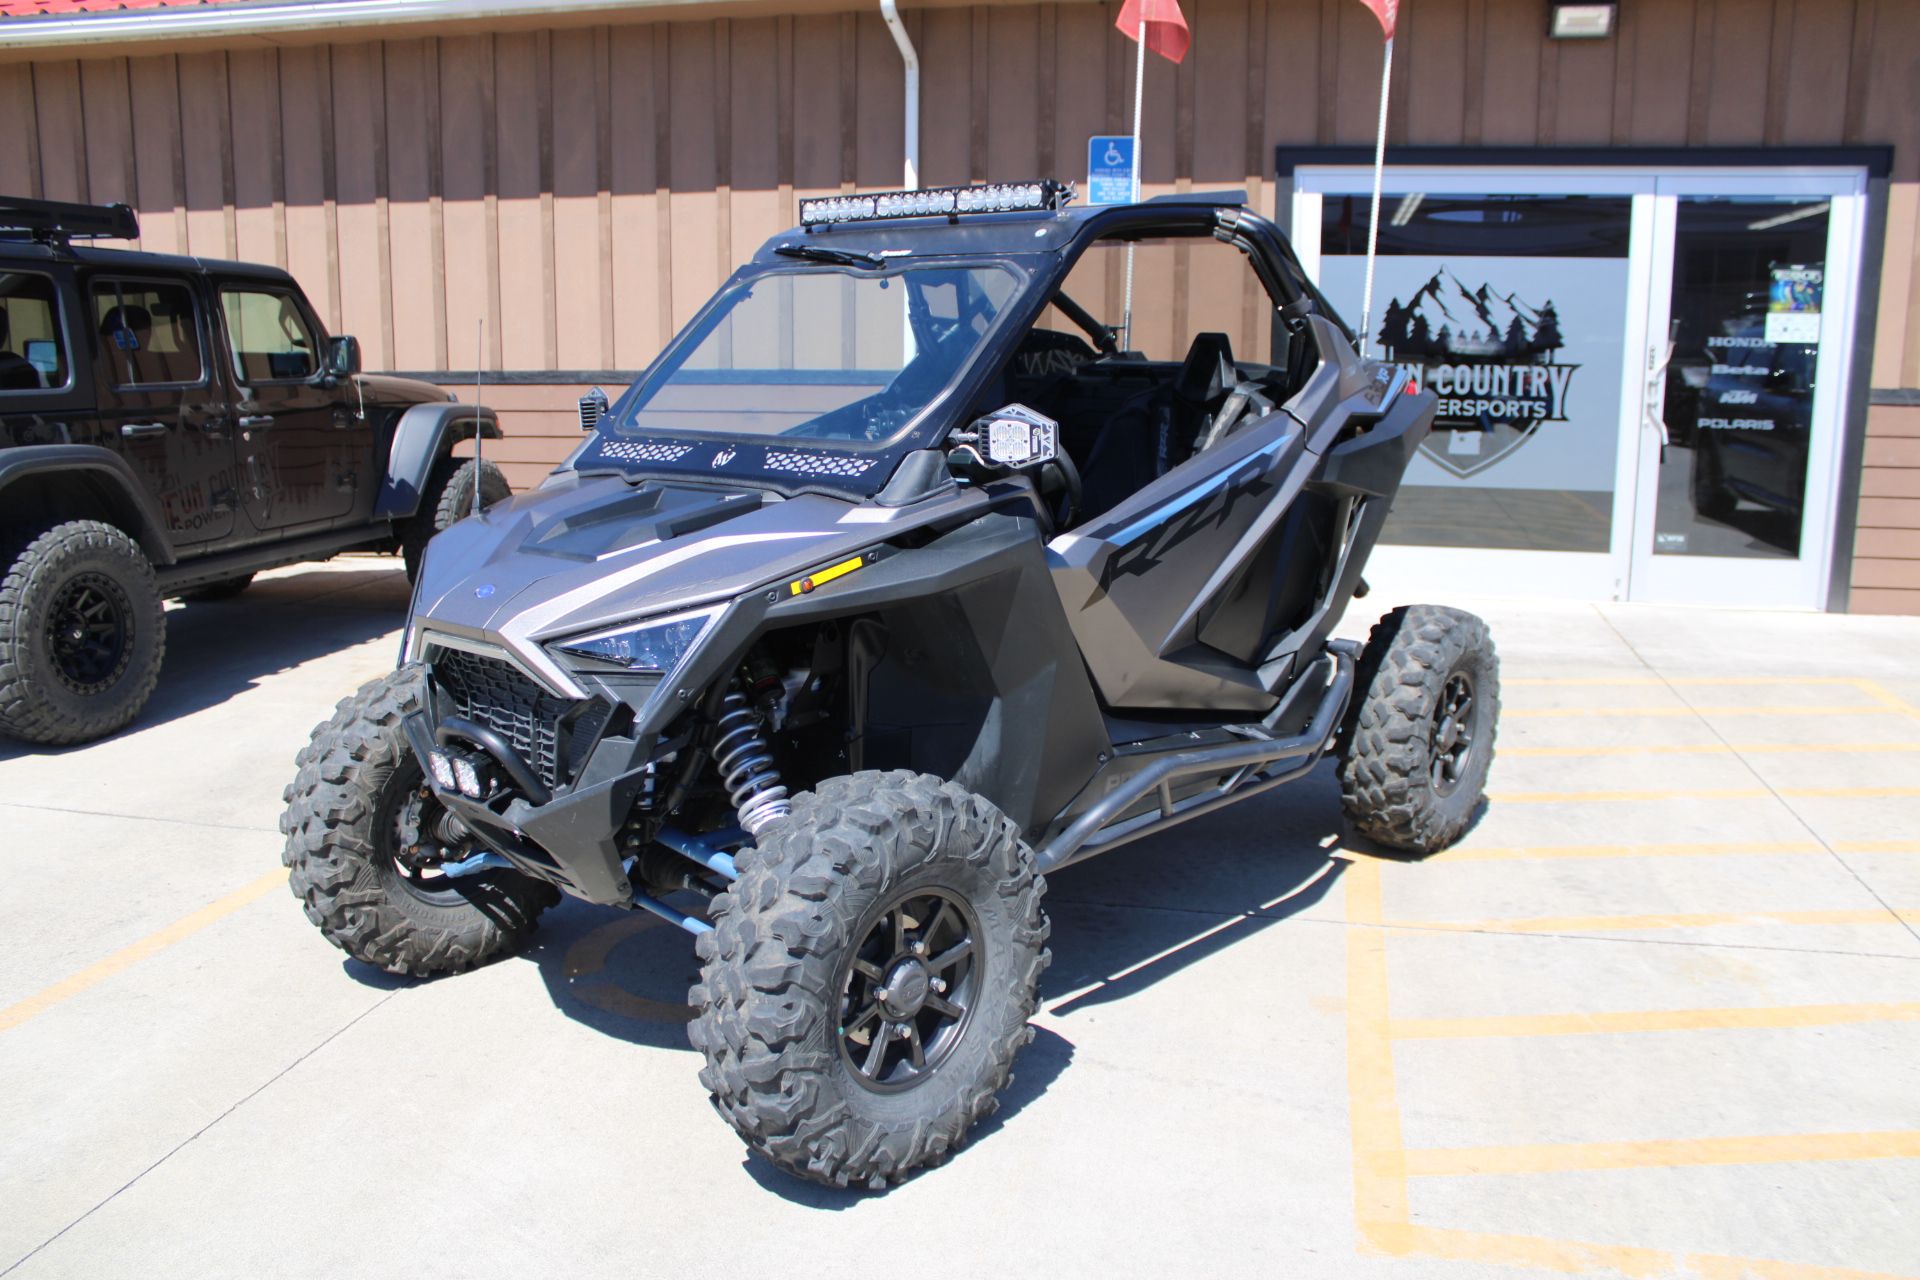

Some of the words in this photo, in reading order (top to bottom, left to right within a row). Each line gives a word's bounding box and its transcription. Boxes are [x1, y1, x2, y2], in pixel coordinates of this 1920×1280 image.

[1711, 364, 1770, 376] Beta
[1436, 364, 1574, 419] COUNTRY
[1719, 389, 1760, 404] KTM
[1697, 418, 1776, 431] POLARIS
[1081, 452, 1274, 612] RZR
